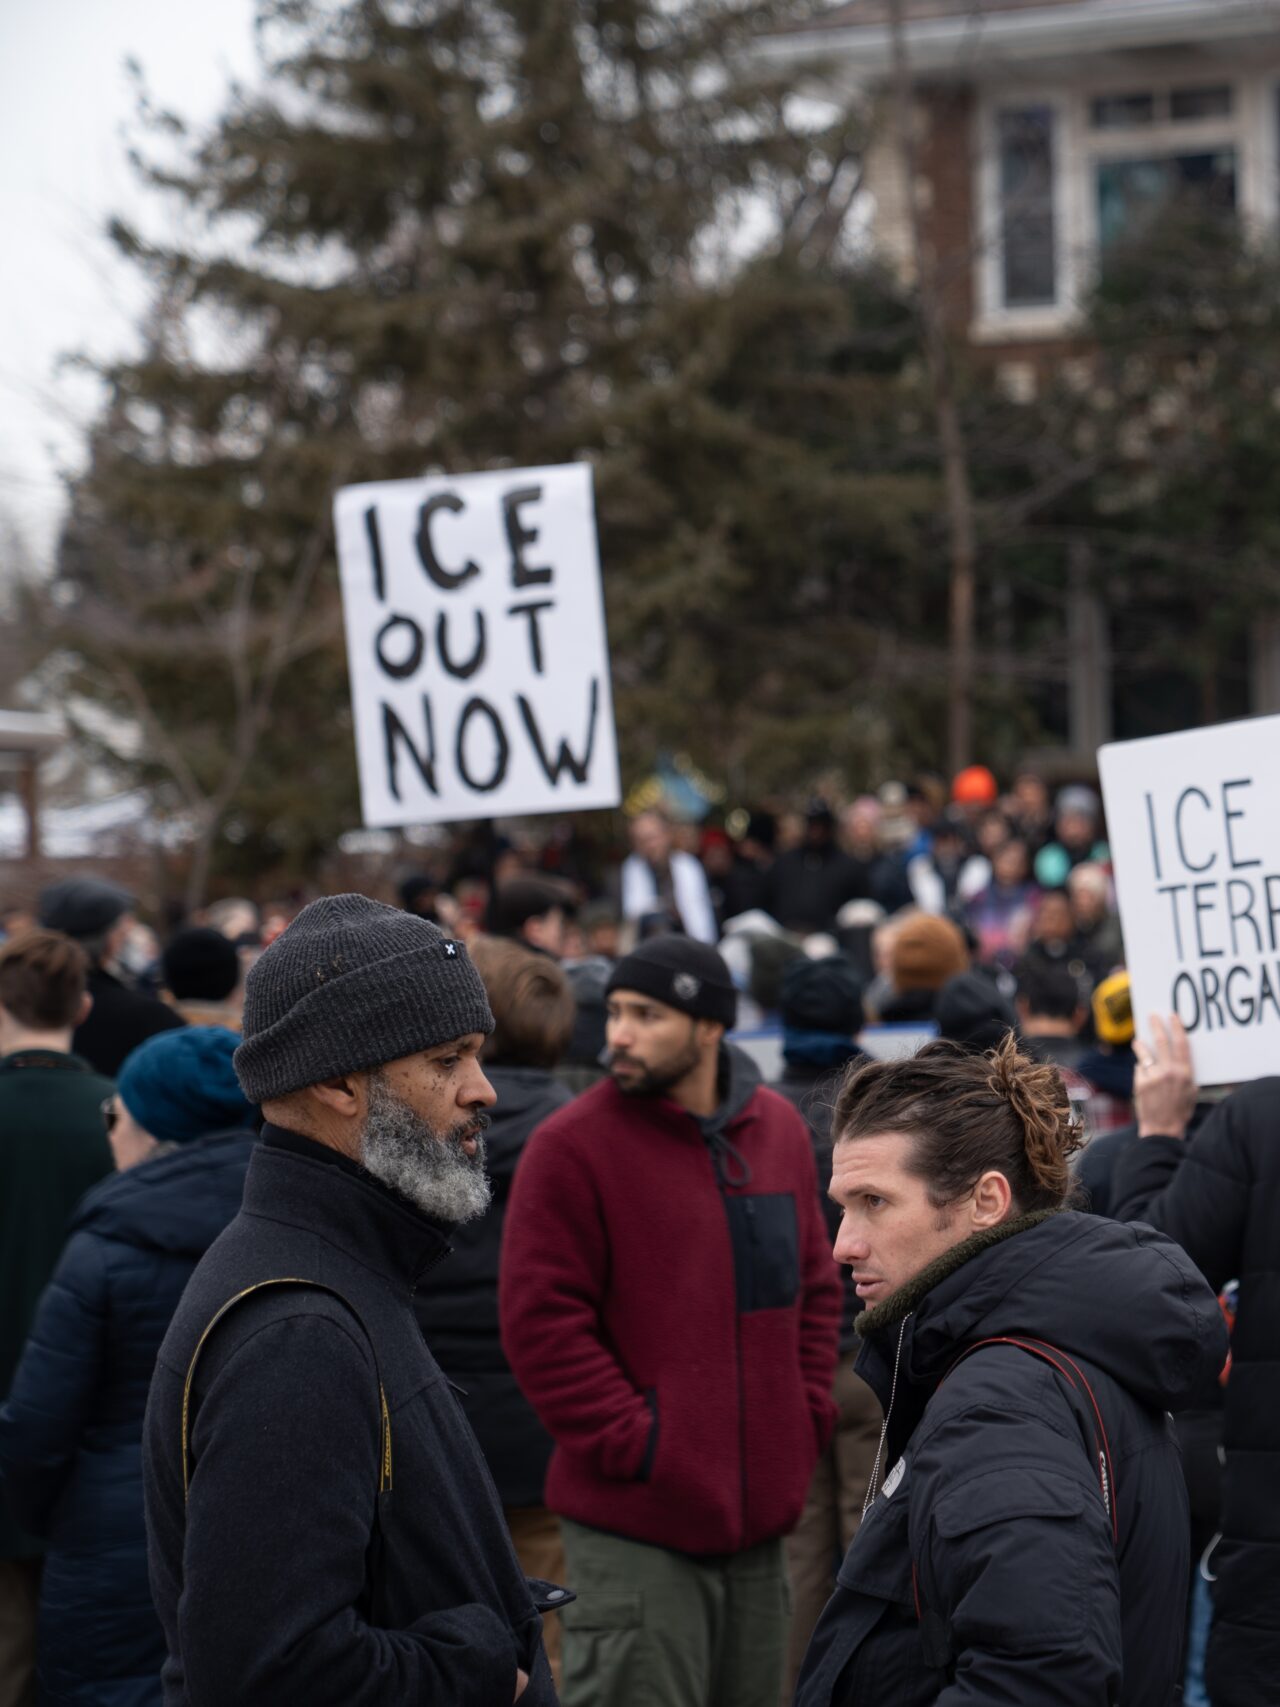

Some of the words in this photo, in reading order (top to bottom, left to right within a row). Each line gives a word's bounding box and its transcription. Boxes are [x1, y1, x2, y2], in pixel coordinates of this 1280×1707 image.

[363, 485, 555, 603] ICE
[374, 600, 556, 681] OUT
[380, 678, 600, 802] NOW
[1144, 778, 1261, 880] ICE
